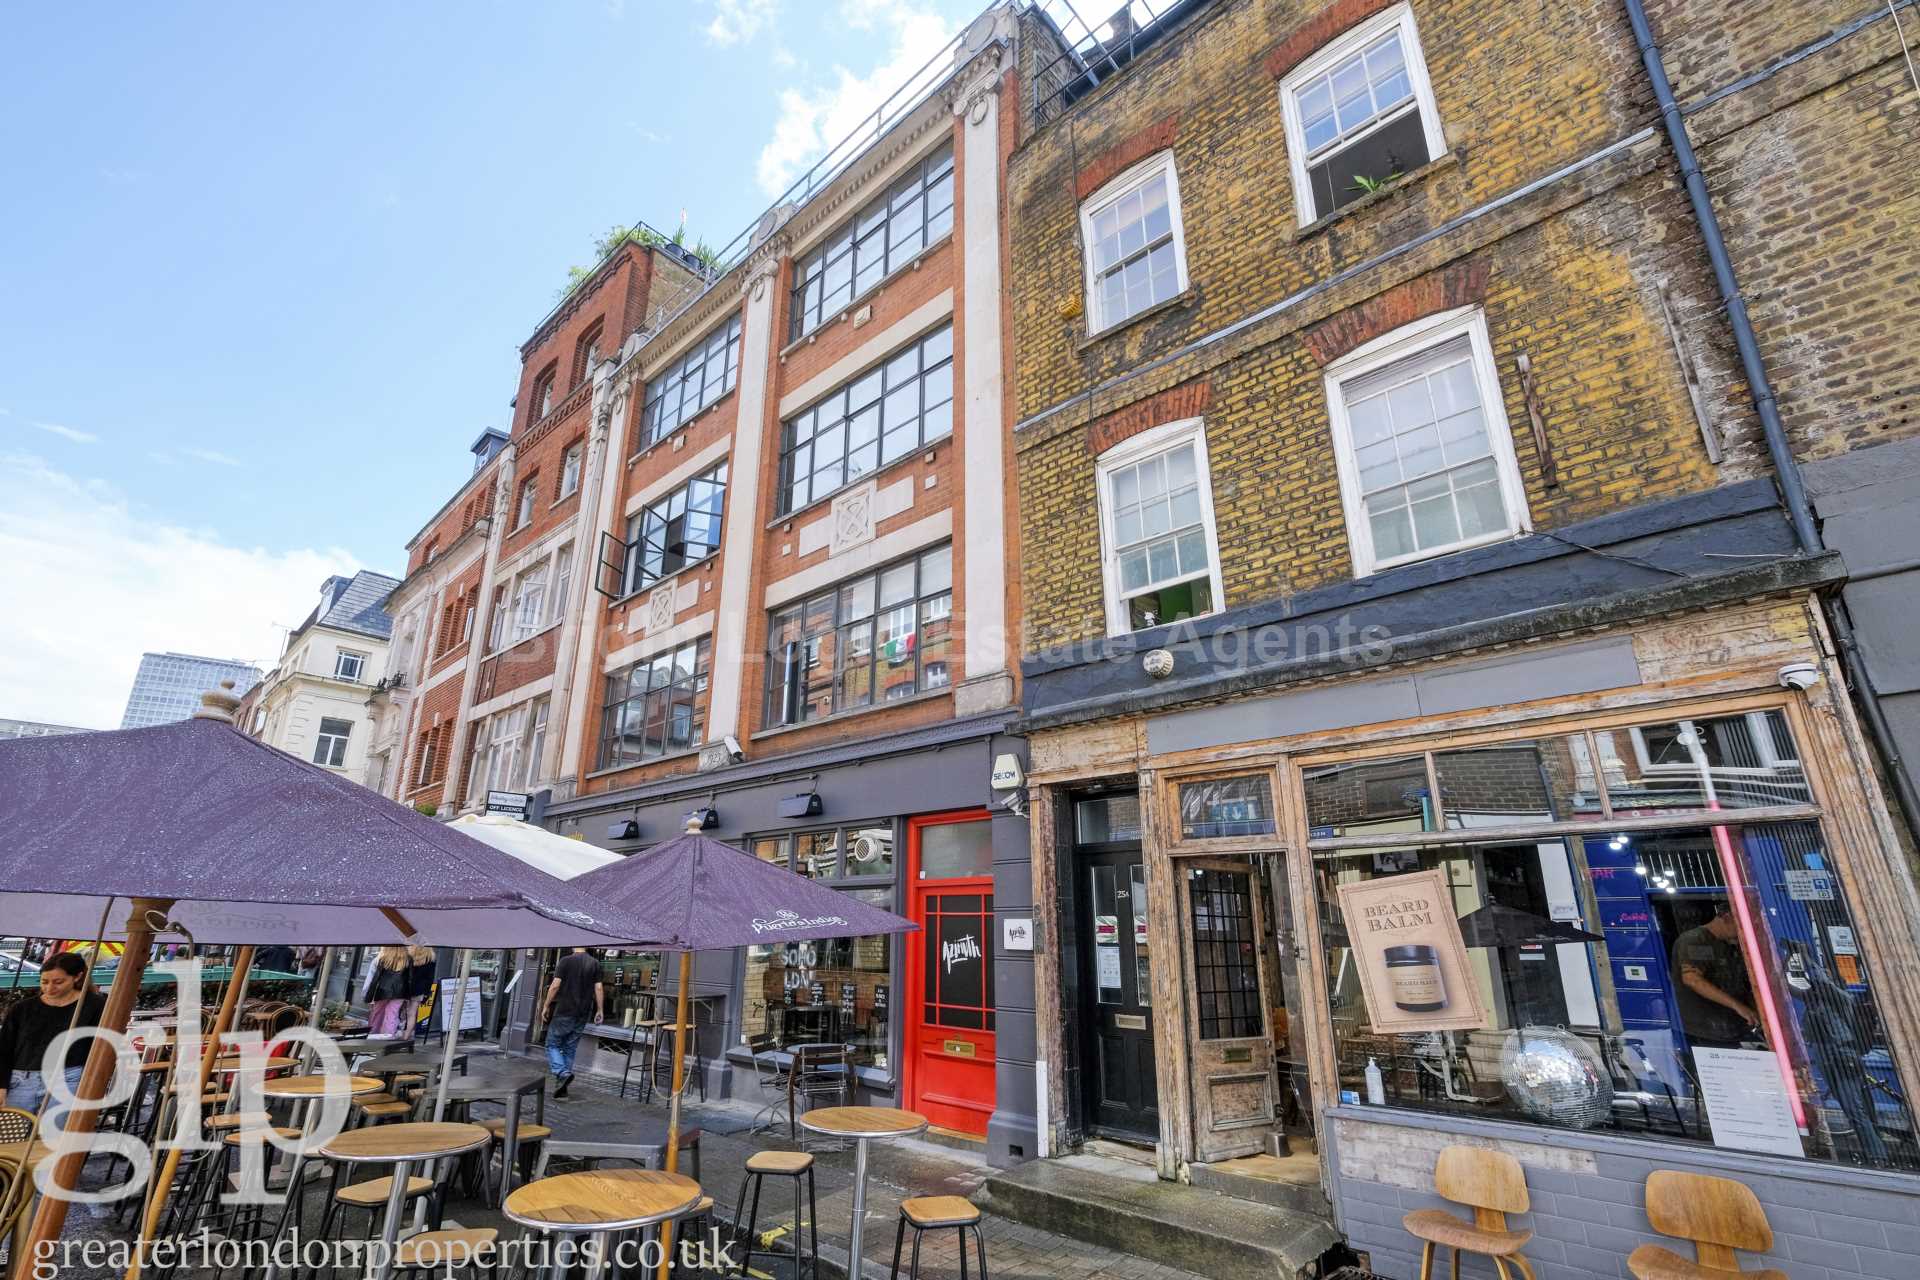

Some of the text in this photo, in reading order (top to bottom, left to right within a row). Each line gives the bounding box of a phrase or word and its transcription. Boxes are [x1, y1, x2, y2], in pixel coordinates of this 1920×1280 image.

[489, 804, 523, 814] OFF LICENCE
[1363, 899, 1429, 918] BEARD
[1366, 911, 1433, 932] BALM
[782, 948, 817, 967] SOHO
[784, 969, 810, 990] LDN
